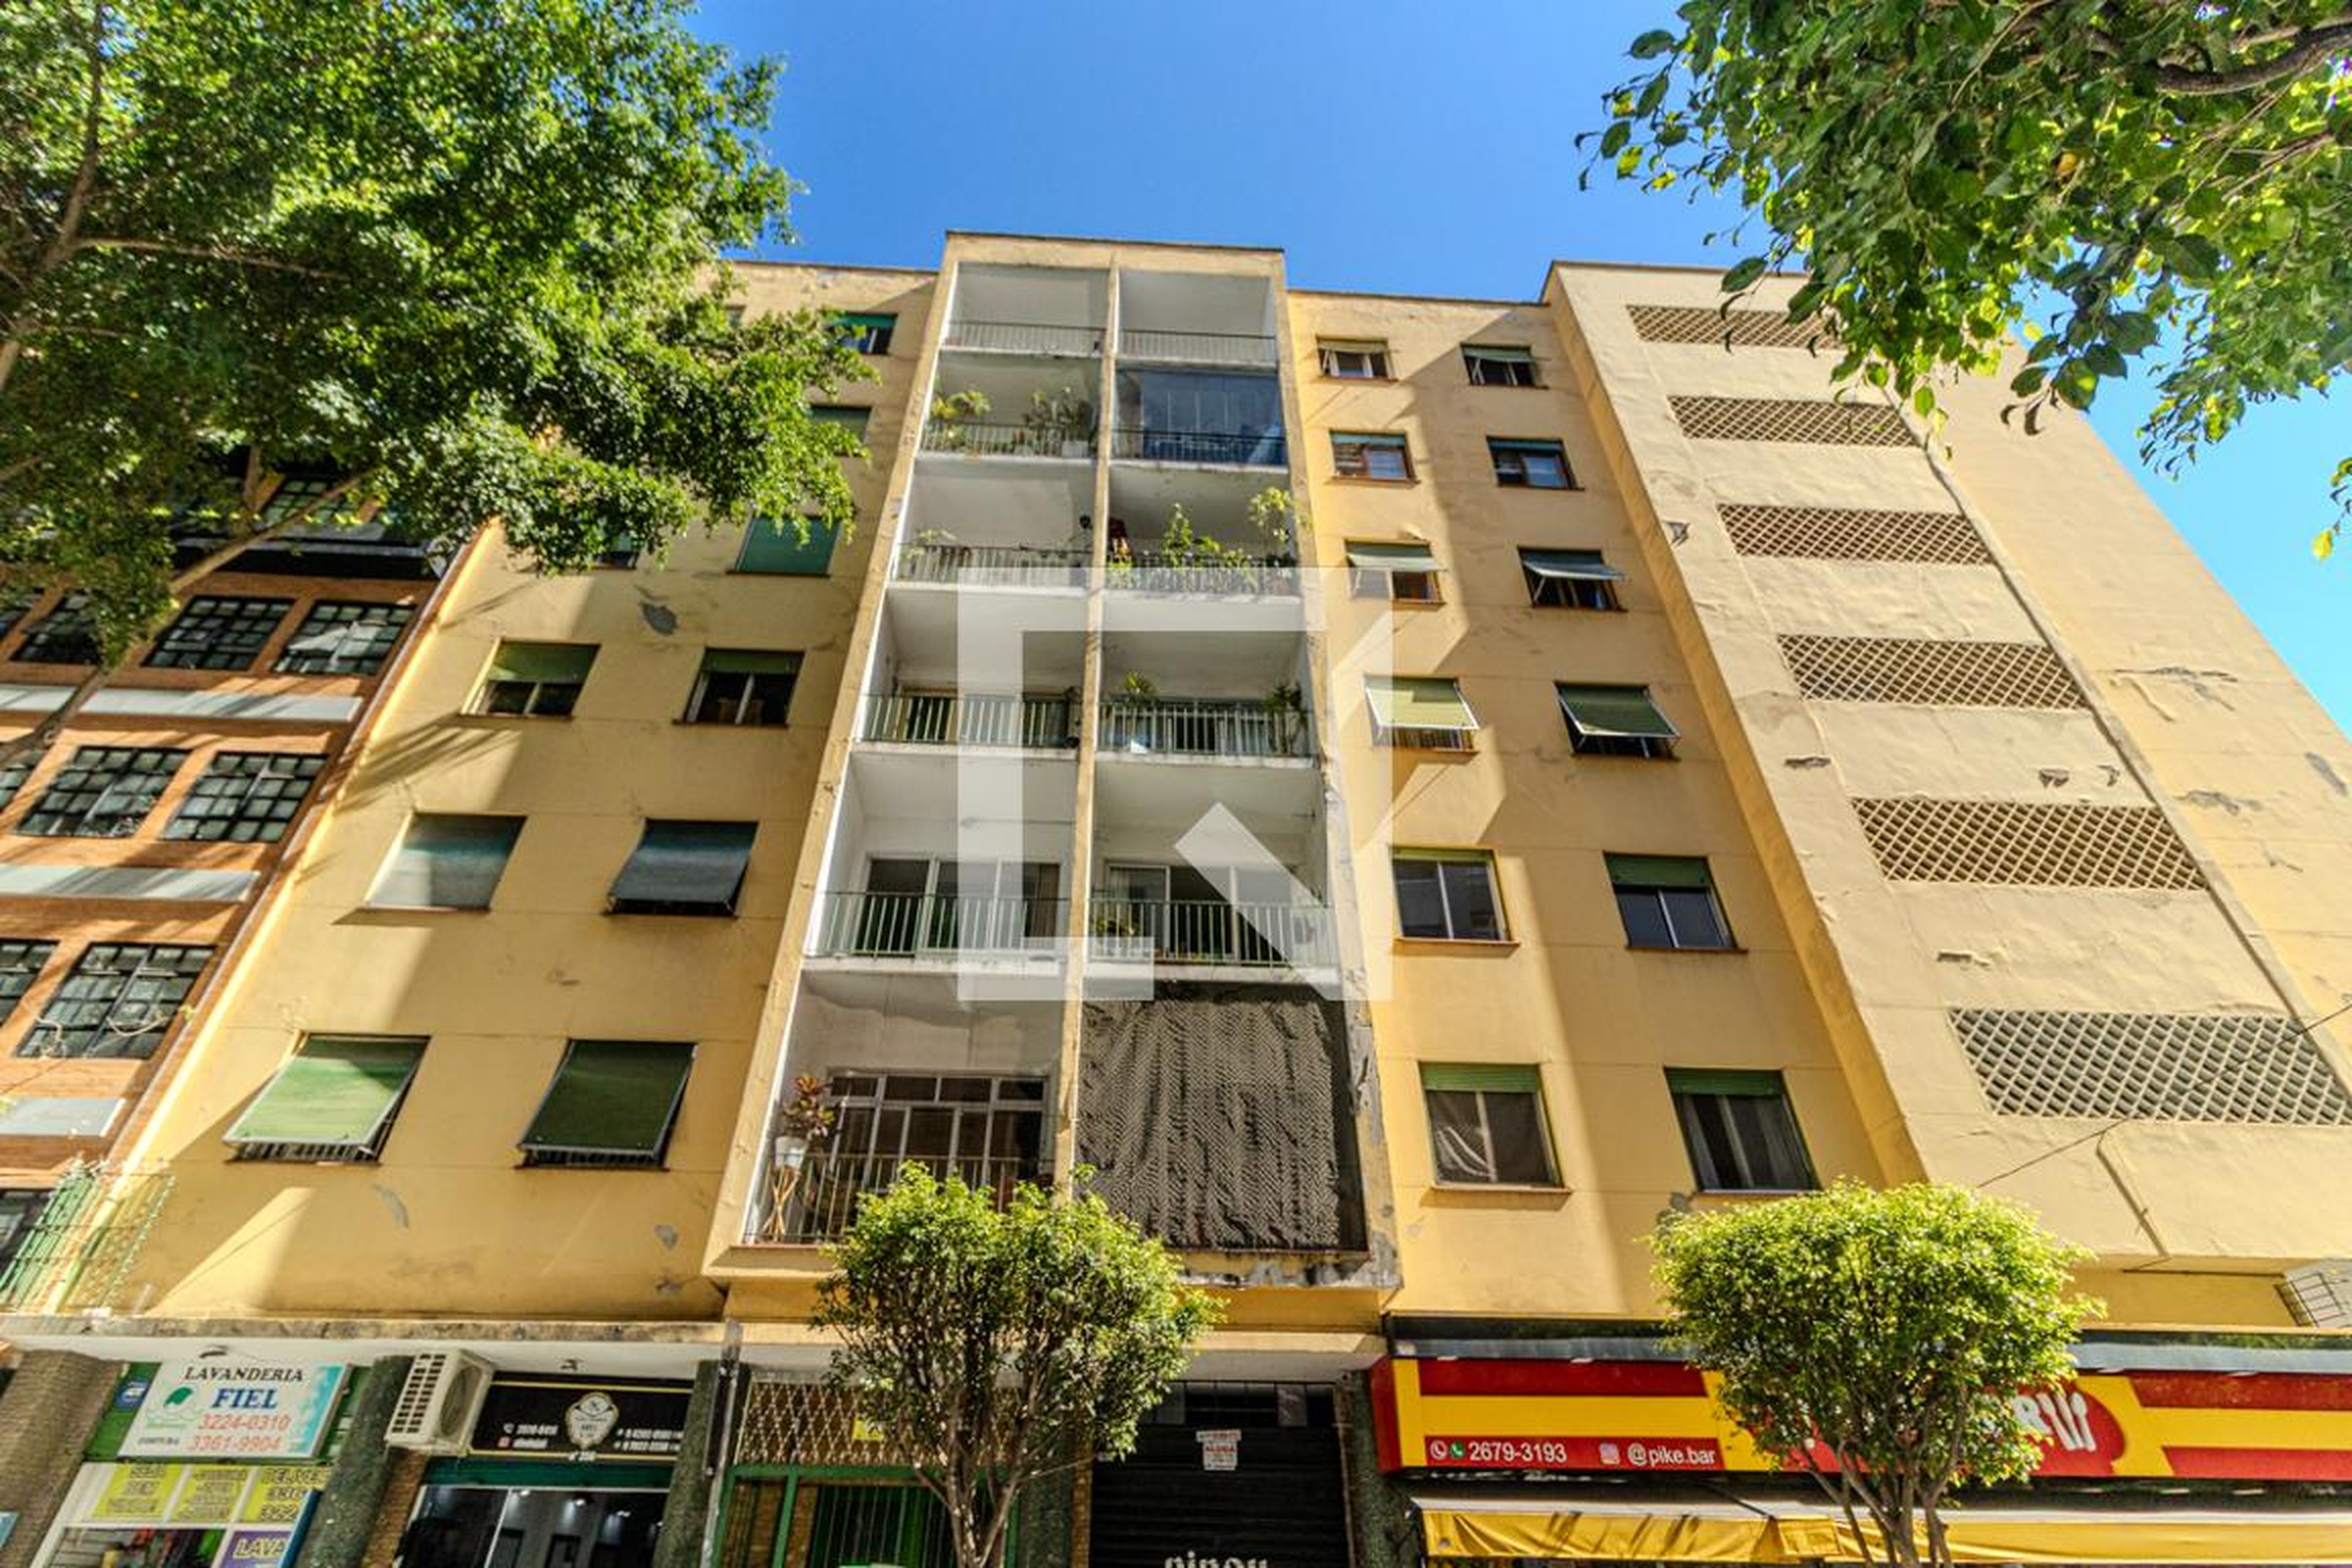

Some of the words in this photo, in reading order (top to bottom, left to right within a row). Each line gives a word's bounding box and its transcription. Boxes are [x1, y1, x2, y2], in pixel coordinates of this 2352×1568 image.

[184, 1366, 304, 1381] LAVANDERIA
[211, 1387, 278, 1409] FIEL
[197, 1413, 292, 1430] 3224-0310
[1469, 1441, 1567, 1463] 2679-3193
[1627, 1444, 1716, 1466] @pike.bar
